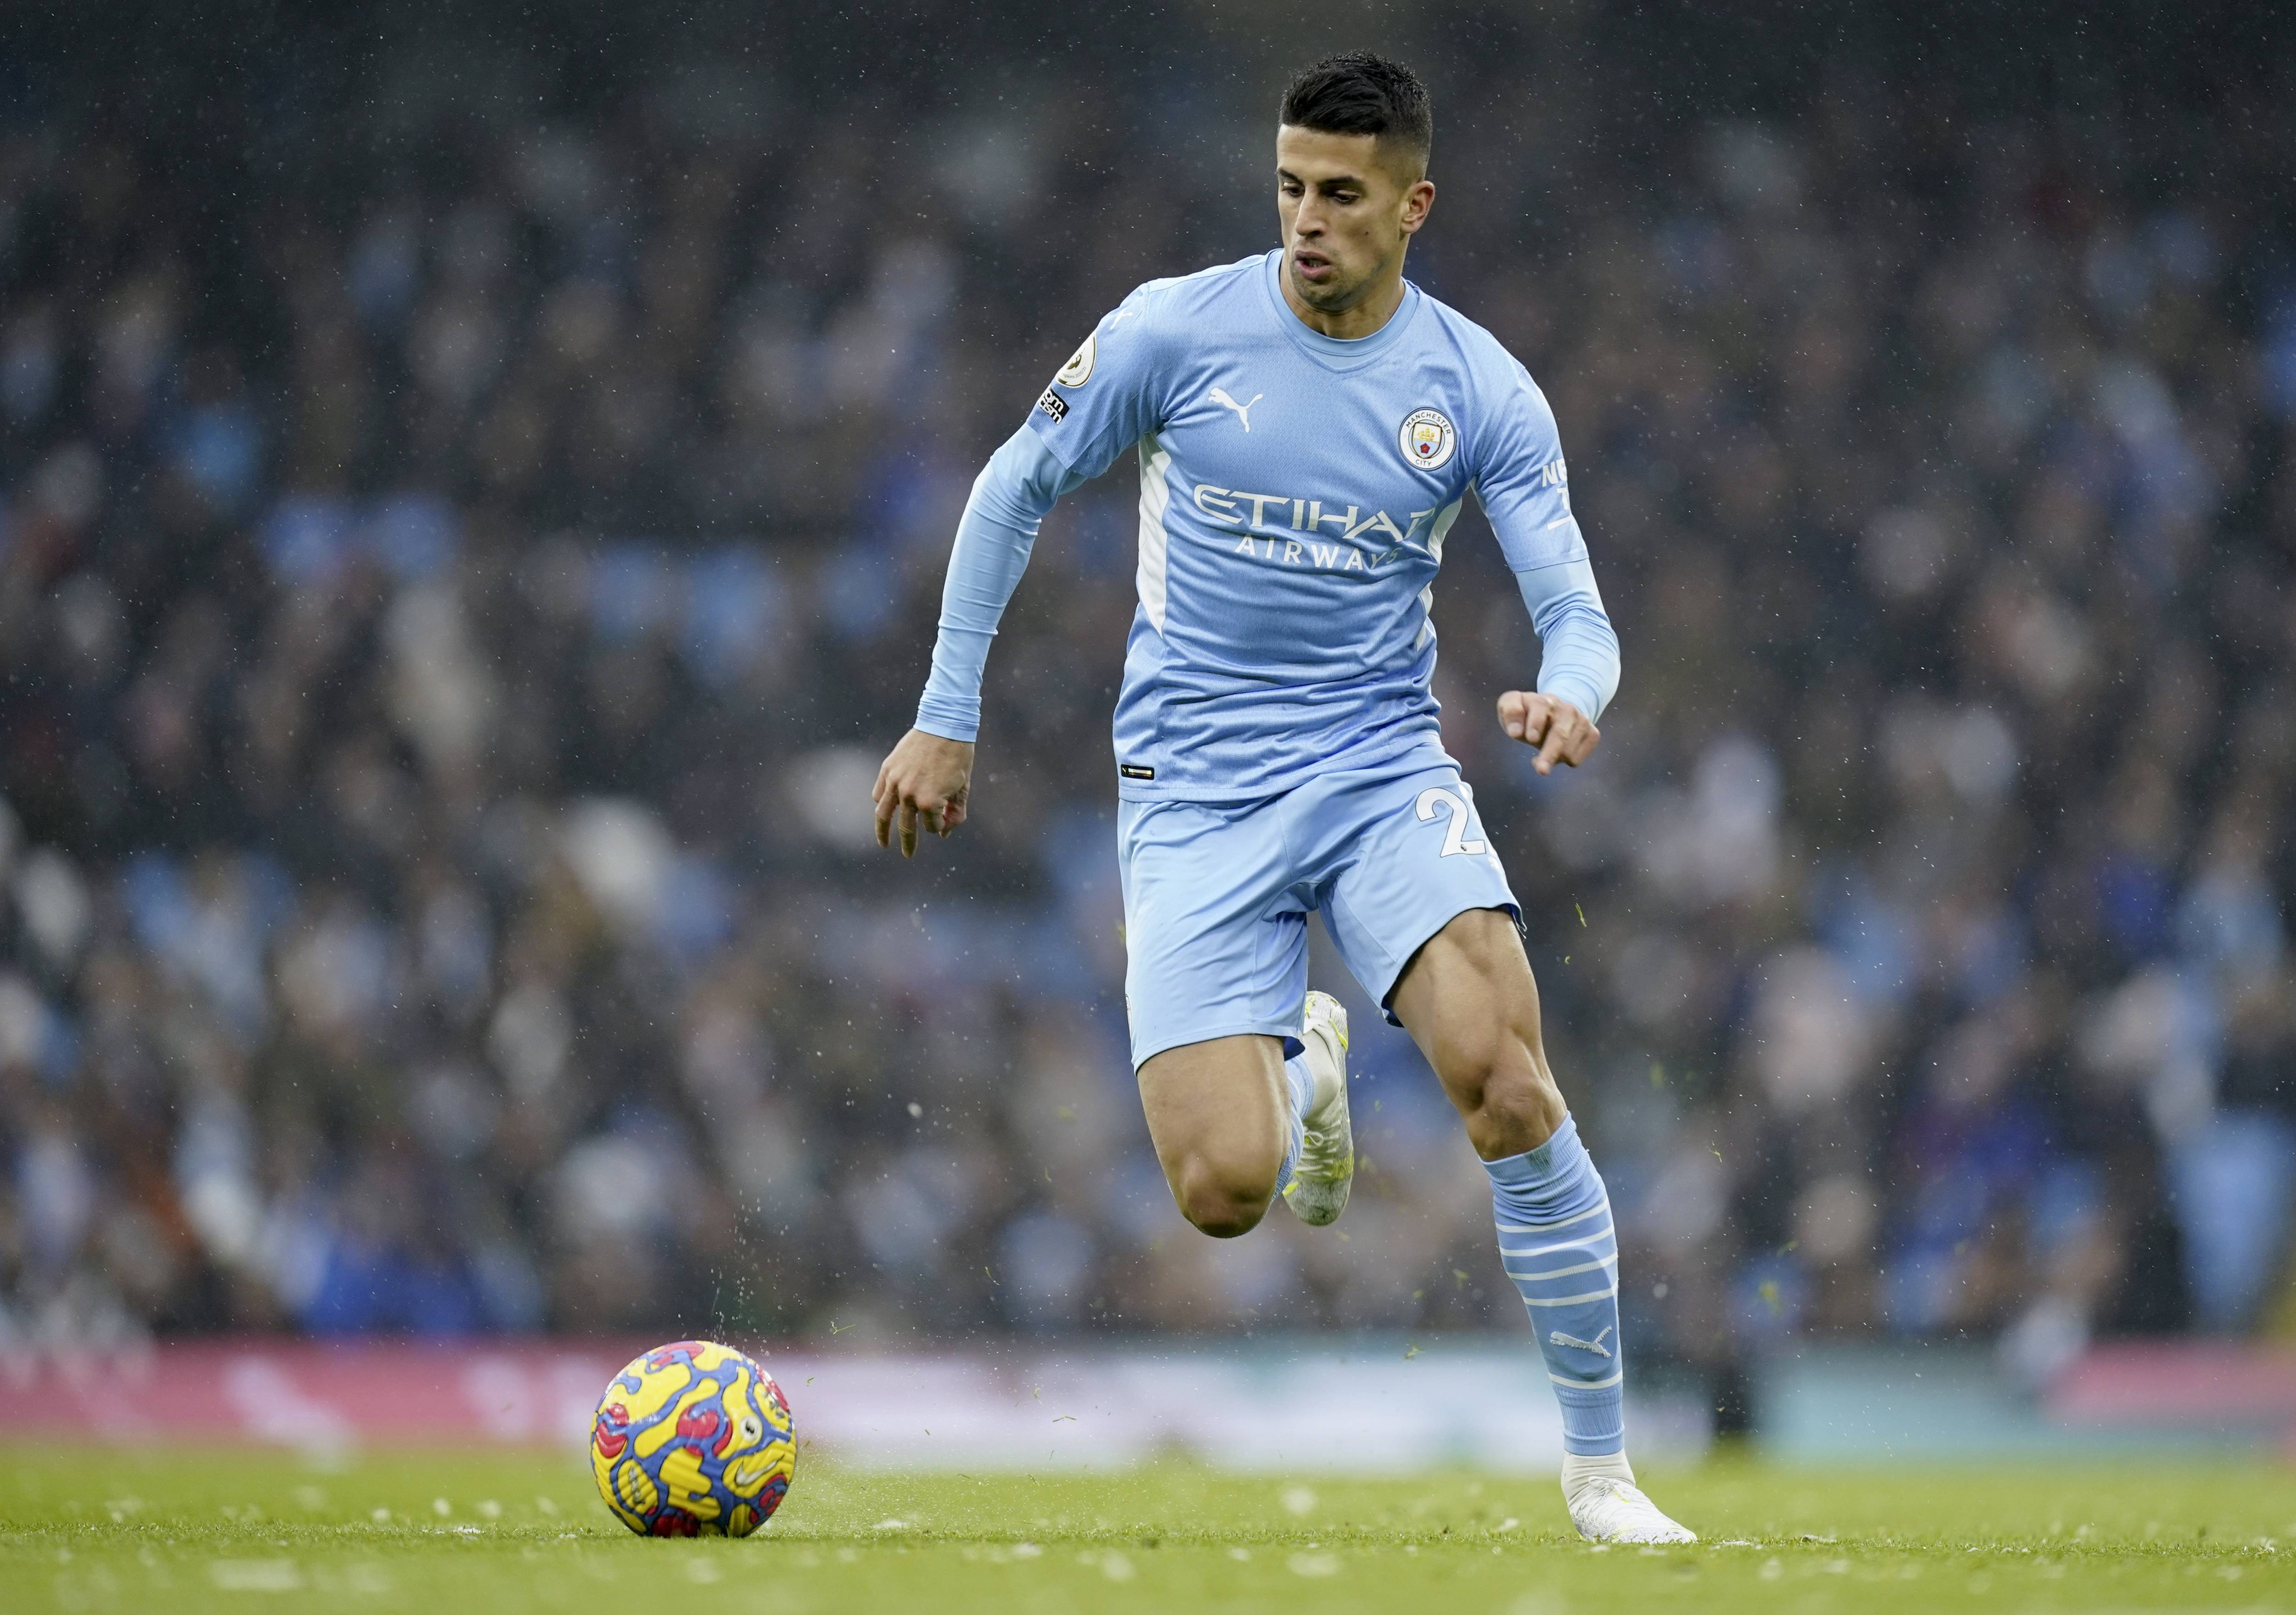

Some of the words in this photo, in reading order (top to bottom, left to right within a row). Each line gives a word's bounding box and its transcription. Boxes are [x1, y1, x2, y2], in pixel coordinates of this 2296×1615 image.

[1038, 397, 1063, 425] cism
[1406, 412, 1451, 435] MANCHESTER
[1234, 533, 1403, 570] AIRWAYS
